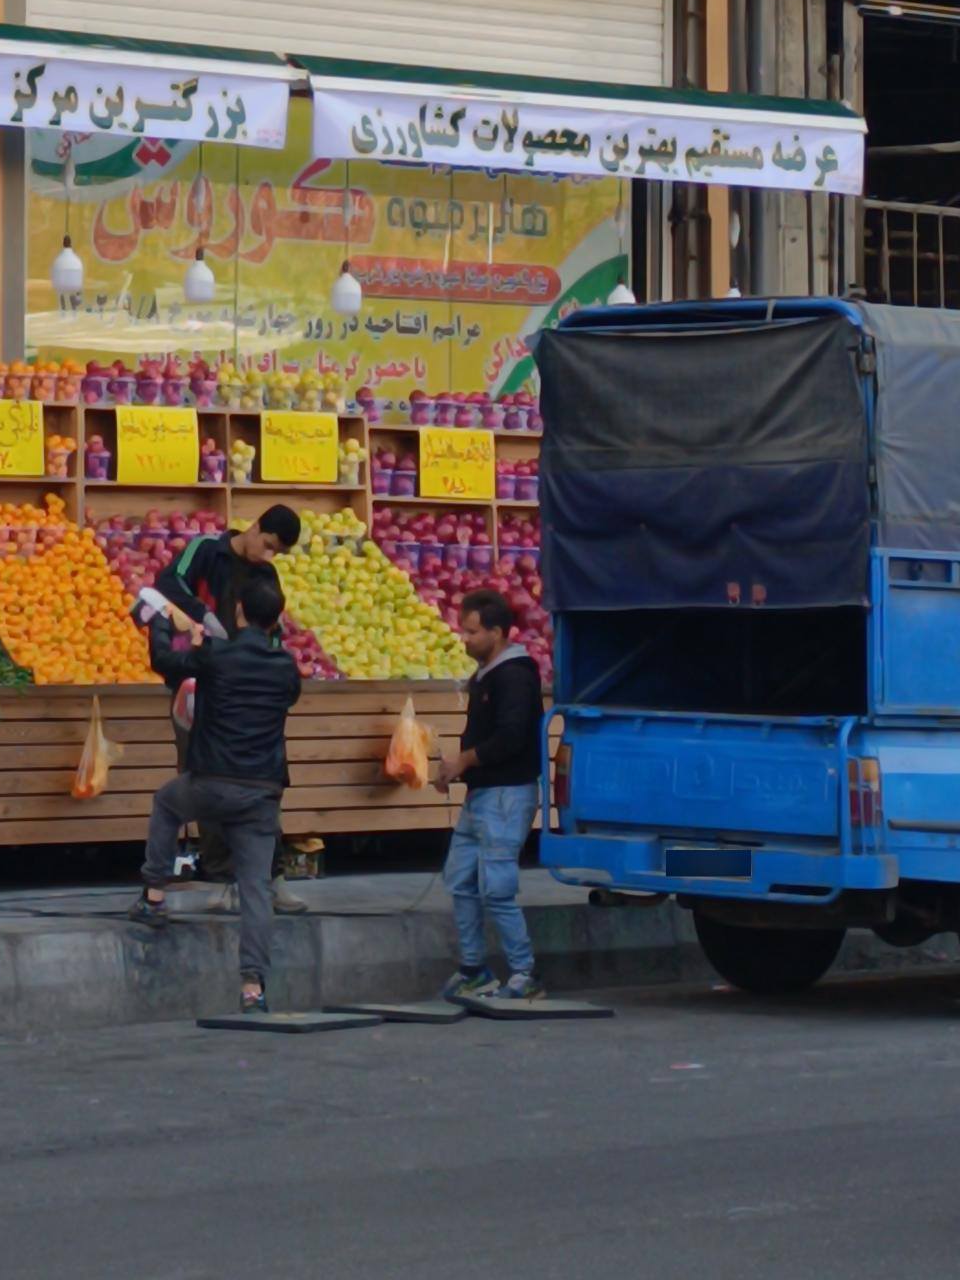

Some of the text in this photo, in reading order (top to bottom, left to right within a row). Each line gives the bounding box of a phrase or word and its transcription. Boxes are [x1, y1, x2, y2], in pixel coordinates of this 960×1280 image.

[11, 65, 77, 125] مرکز
[89, 77, 247, 140] بزرگترین
[351, 102, 467, 158] کشاورزی
[472, 109, 591, 167] محصولات
[598, 126, 678, 176] بهترین
[684, 129, 766, 179] مستقیم
[771, 129, 839, 187] عرضه
[339, 314, 359, 341] در
